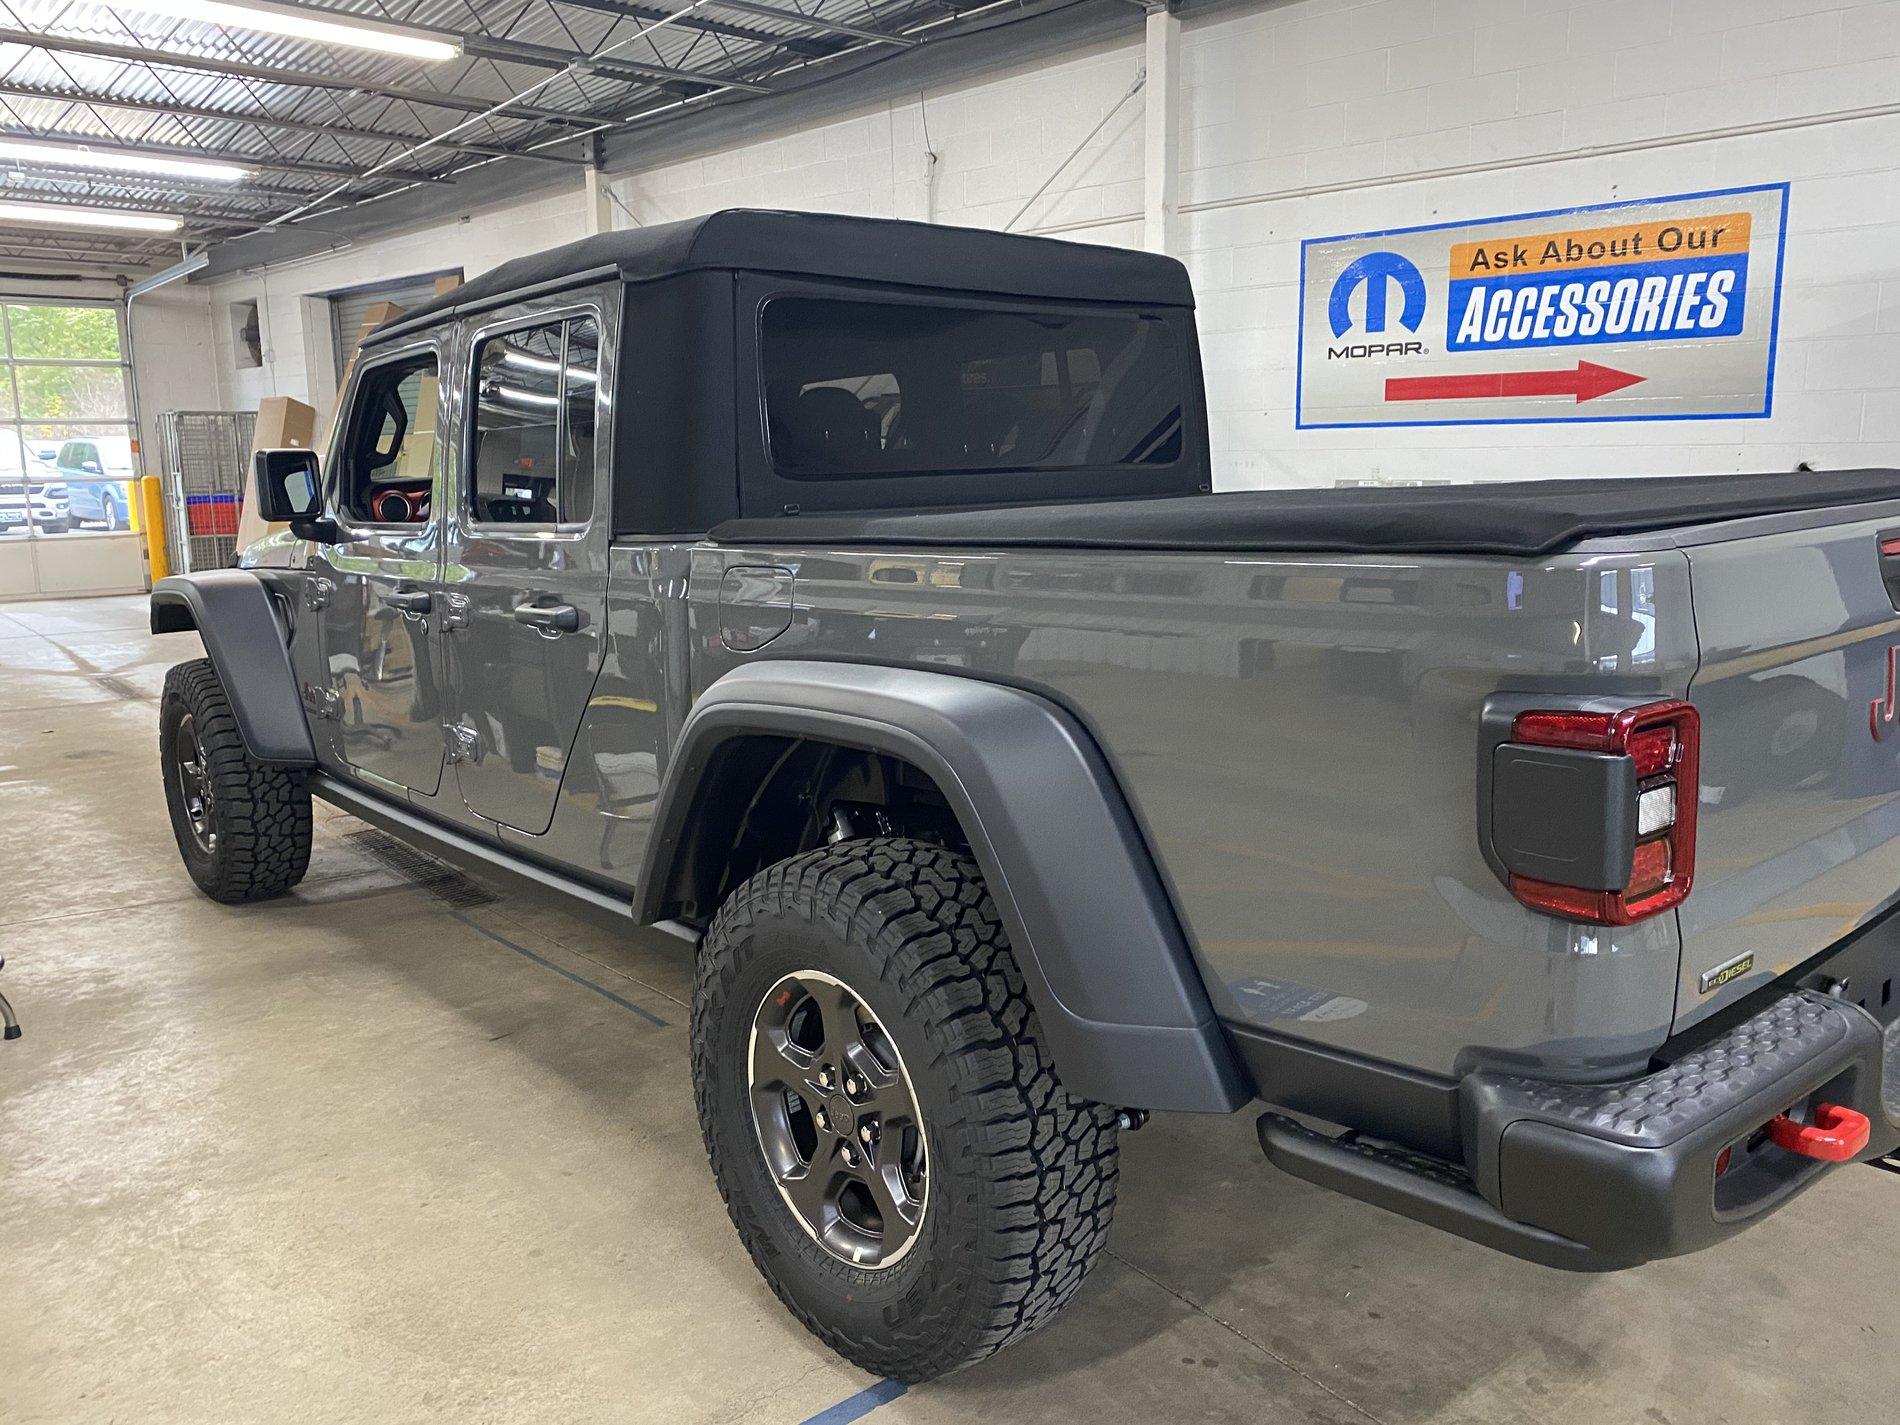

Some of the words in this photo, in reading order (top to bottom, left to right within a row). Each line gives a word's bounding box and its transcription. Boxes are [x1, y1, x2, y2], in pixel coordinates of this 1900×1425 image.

[1469, 244, 1528, 271] Ask
[1539, 232, 1642, 265] About
[1657, 227, 1727, 252] Our
[1455, 269, 1736, 344] ACCESSORIES
